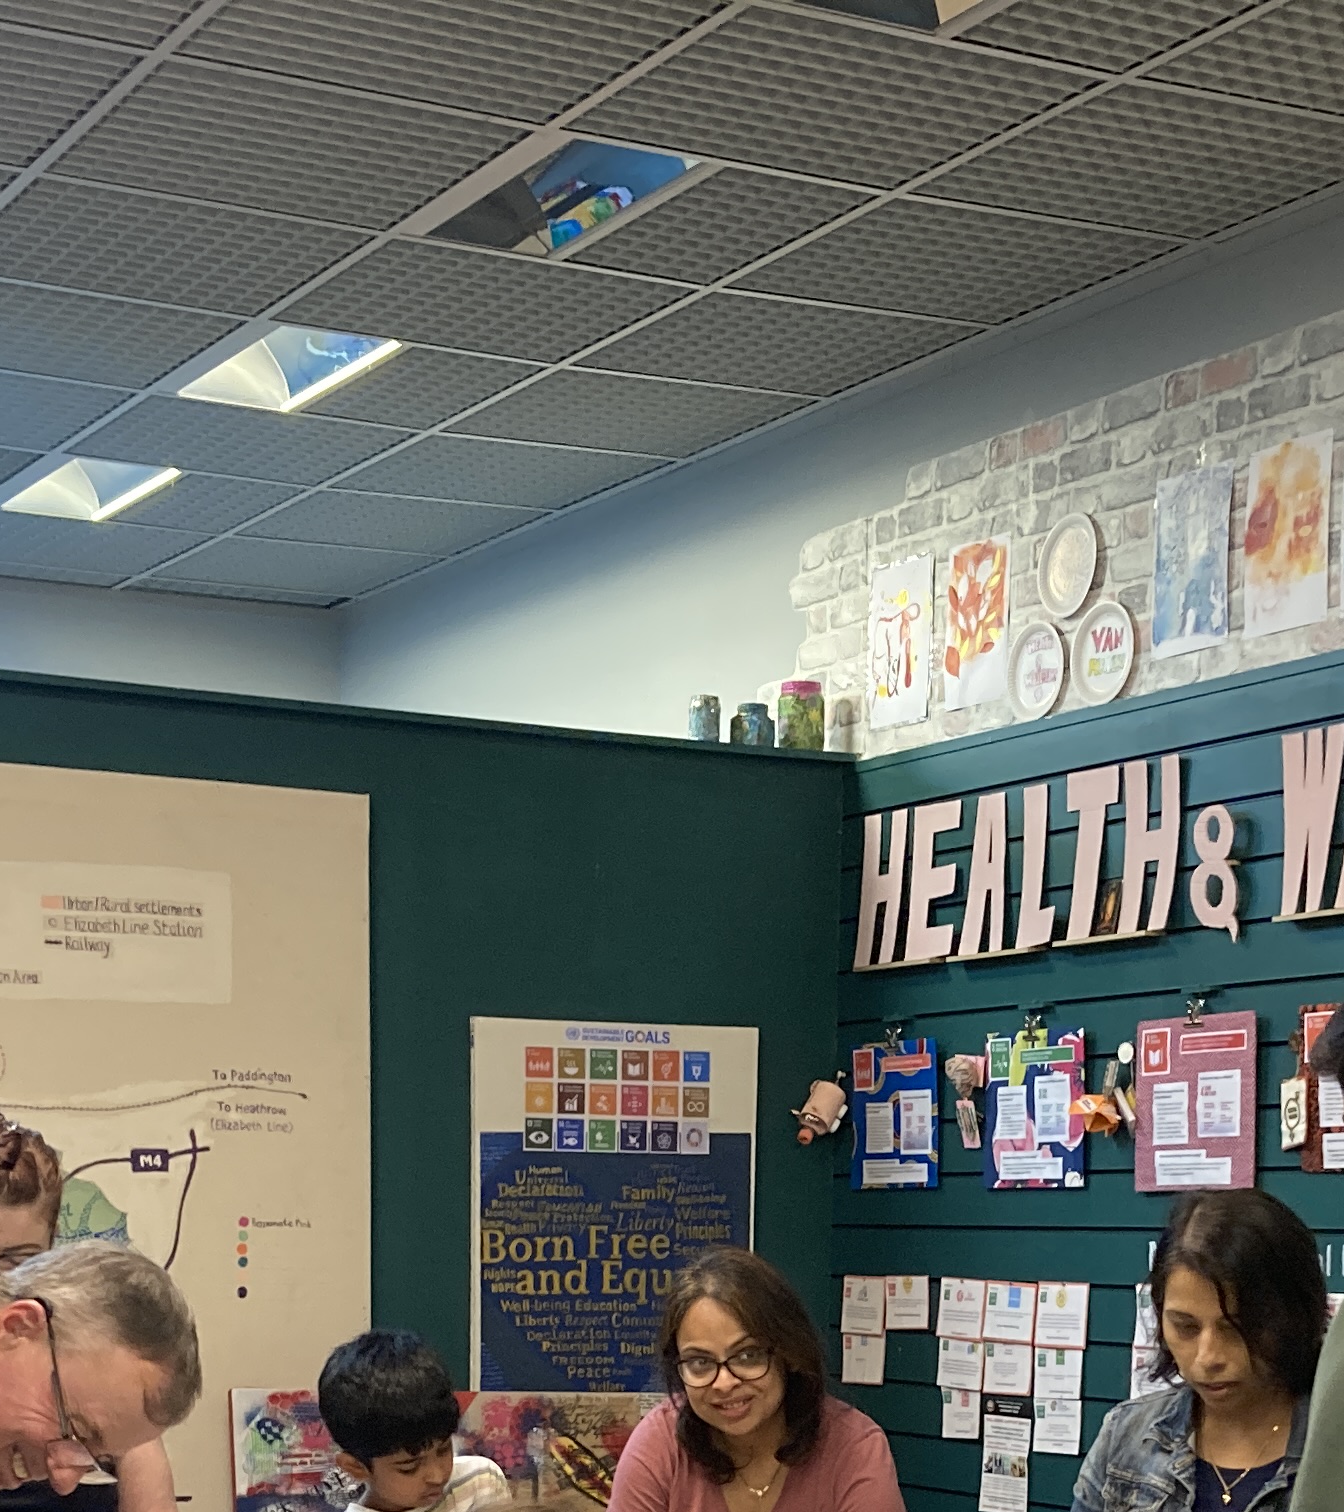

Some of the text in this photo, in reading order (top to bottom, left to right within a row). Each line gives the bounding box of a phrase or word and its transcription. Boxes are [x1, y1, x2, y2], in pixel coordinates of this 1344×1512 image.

[857, 754, 1183, 966] HEALTH
[1189, 805, 1240, 945] &
[152, 919, 203, 938] Station
[65, 936, 110, 958] Railway
[625, 1030, 670, 1045] GOALS
[212, 1069, 292, 1086] To Paddington
[218, 1101, 231, 1113] To
[139, 1154, 163, 1168] M4
[622, 1185, 675, 1203] Family
[616, 1211, 675, 1233] Liberty
[482, 1225, 671, 1263] Born Free
[515, 1260, 672, 1305] and Equ
[575, 1299, 637, 1312] Education
[567, 1366, 611, 1380] Peace
